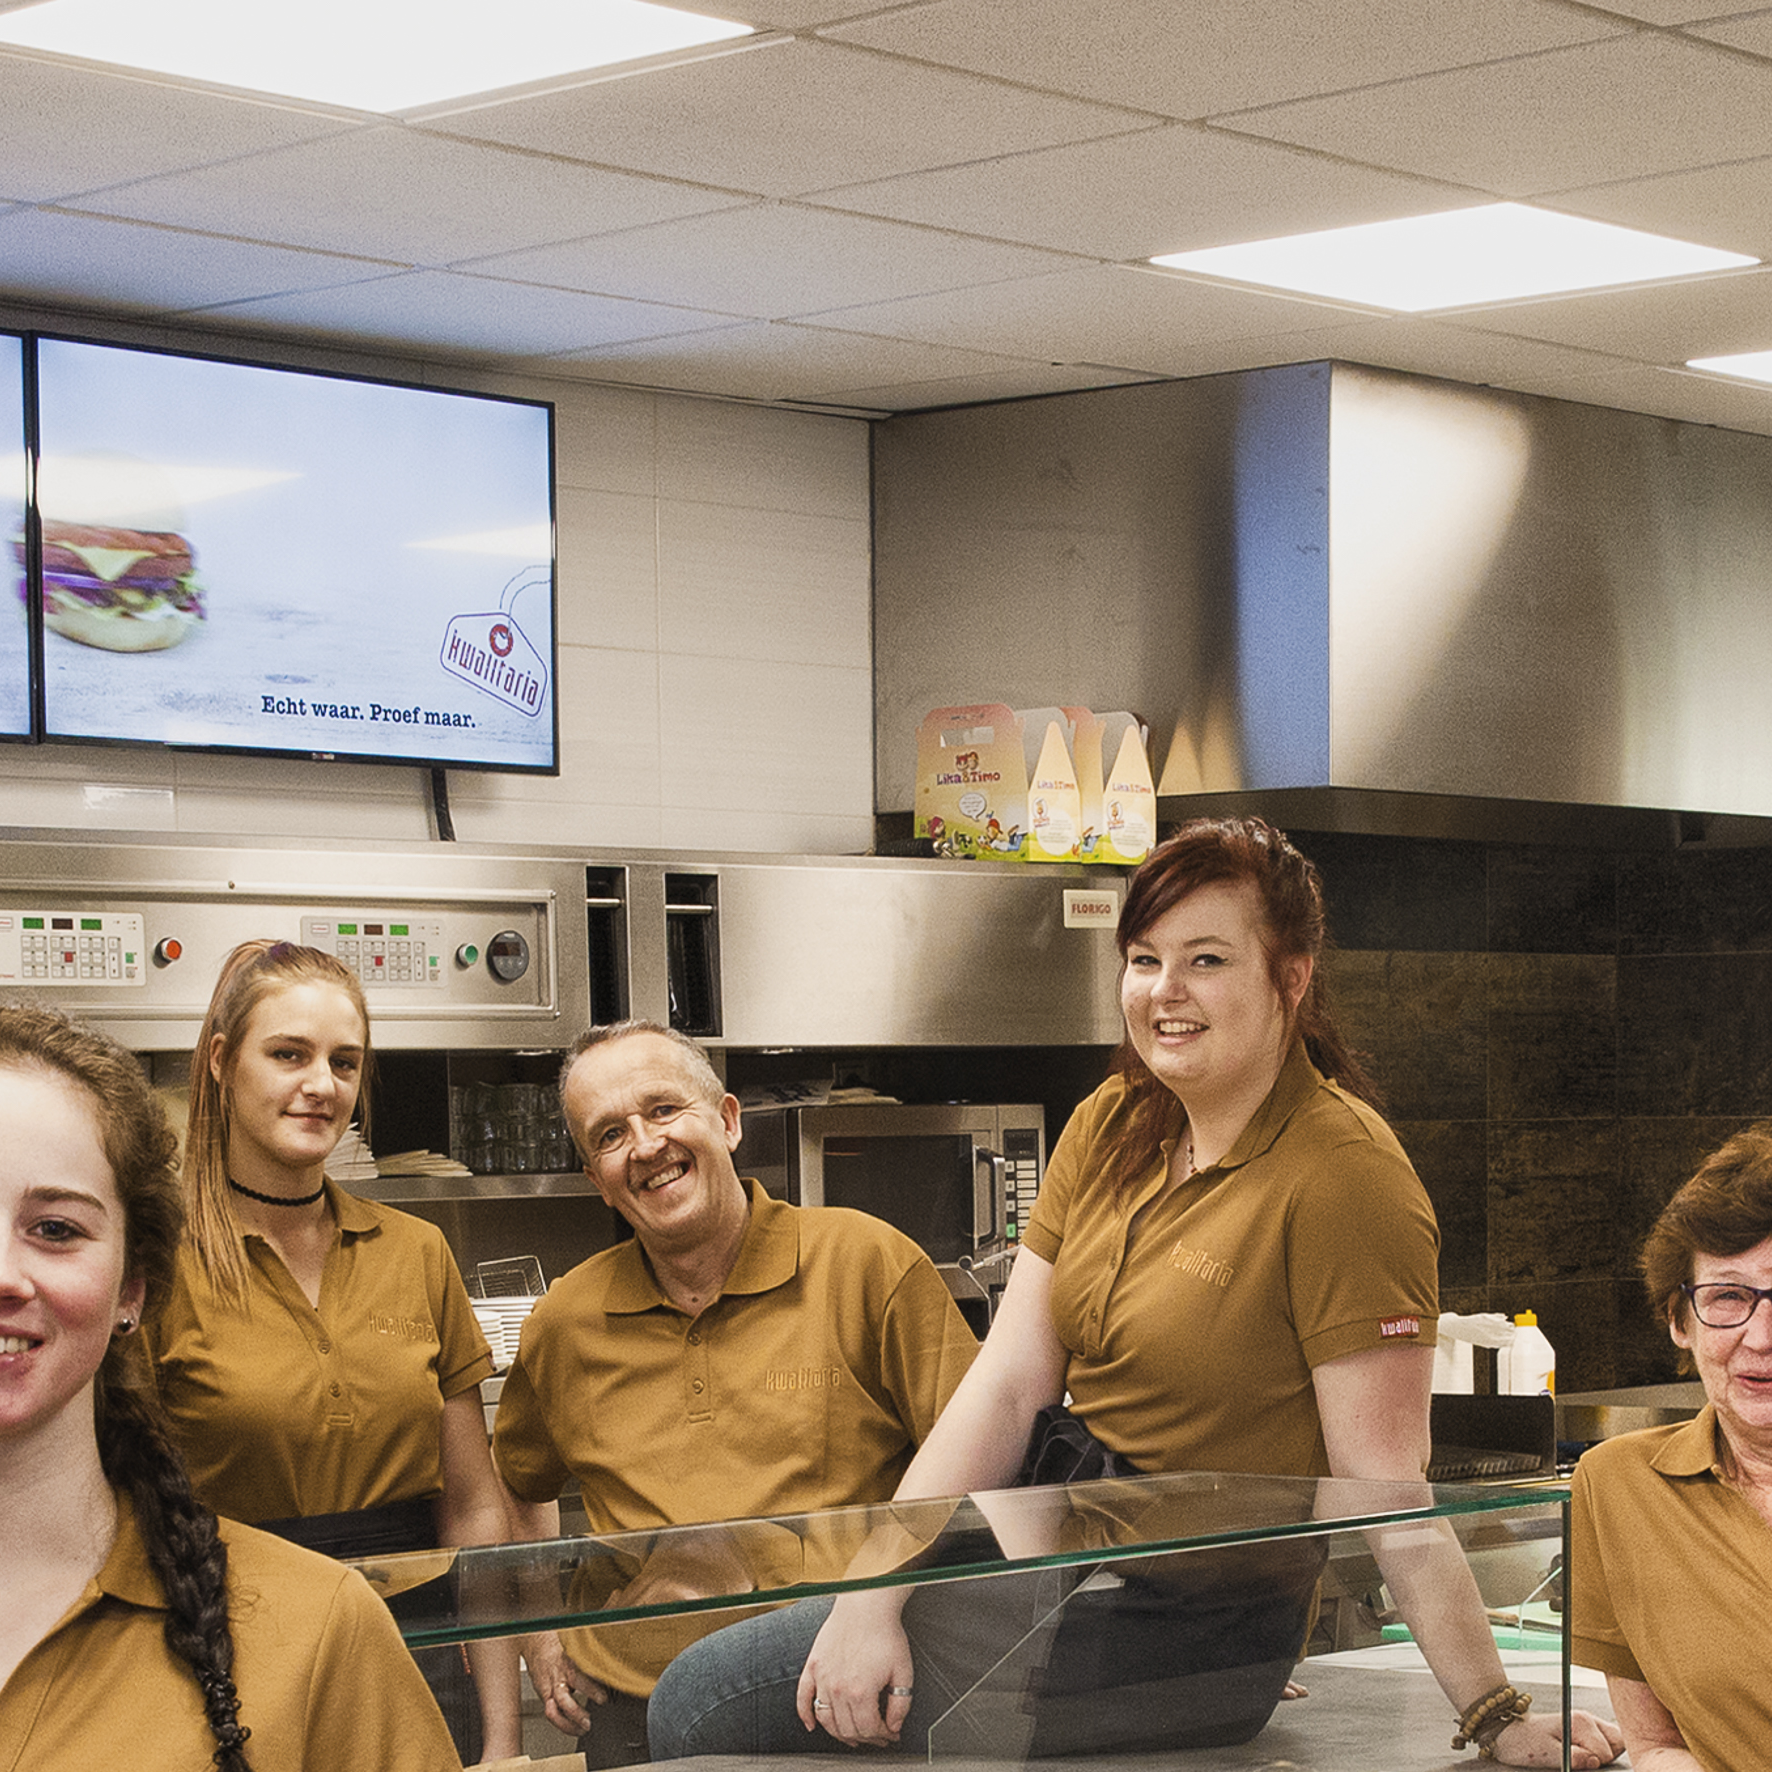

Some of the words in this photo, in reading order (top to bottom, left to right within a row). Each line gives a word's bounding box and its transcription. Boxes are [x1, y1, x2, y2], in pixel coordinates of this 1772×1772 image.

[447, 628, 539, 707] kwalitaria
[261, 695, 307, 717] Echt
[311, 701, 365, 721] waar.
[369, 703, 422, 725] Proef
[424, 711, 477, 729] maar.
[1071, 903, 1112, 915] FLORIGO
